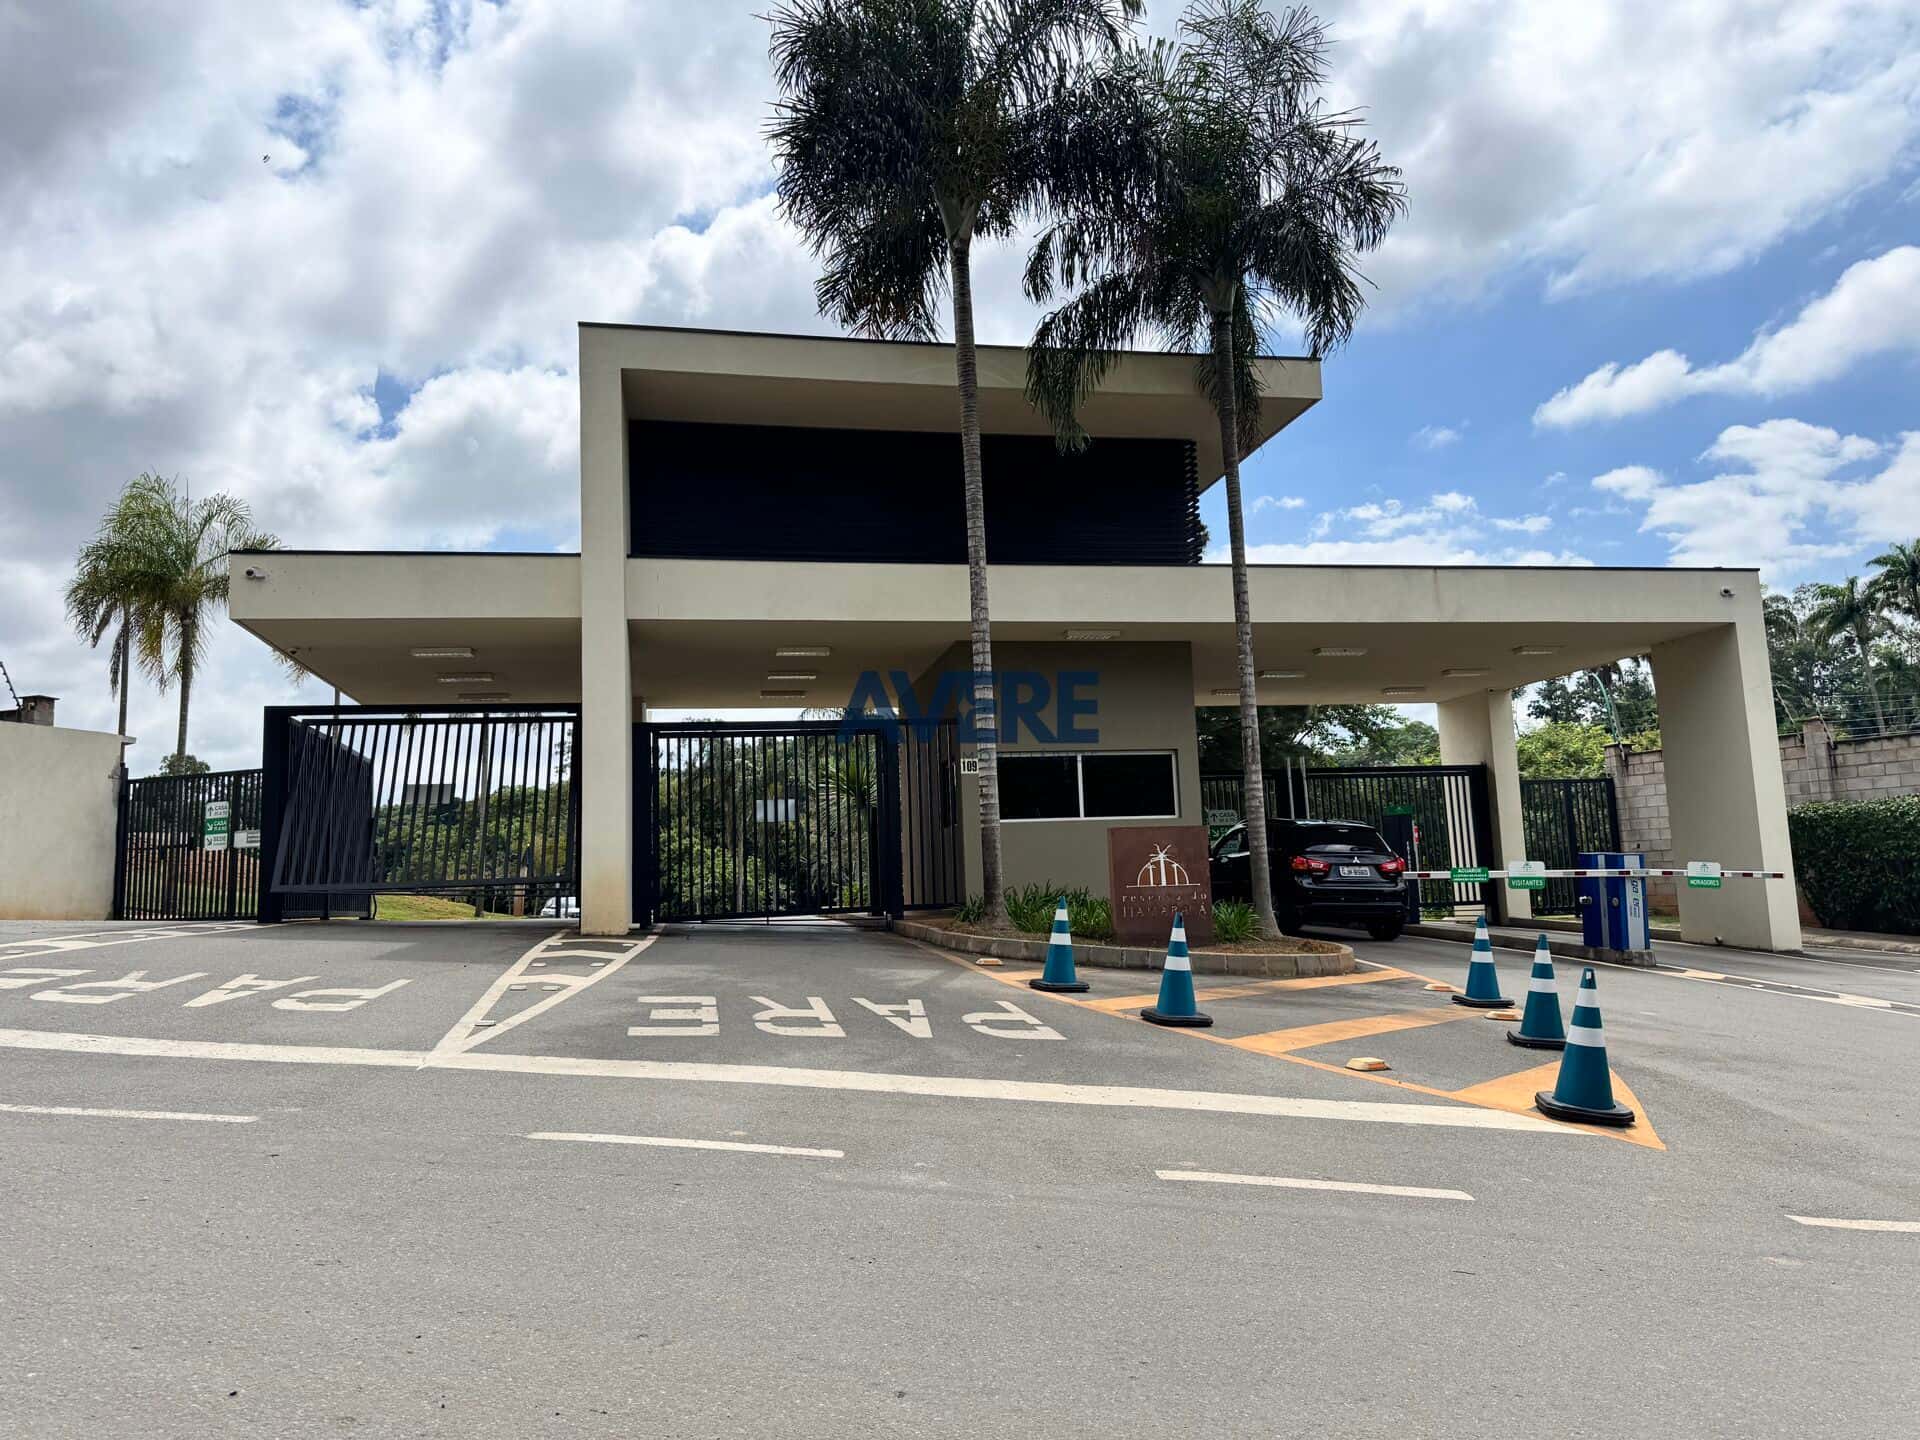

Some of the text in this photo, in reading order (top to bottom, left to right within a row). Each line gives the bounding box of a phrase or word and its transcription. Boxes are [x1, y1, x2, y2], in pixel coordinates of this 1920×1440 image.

[961, 760, 978, 772] 109
[1511, 879, 1544, 887] VISITANTES
[1690, 879, 1720, 887] MORADORES
[627, 995, 1068, 1040] PARE
